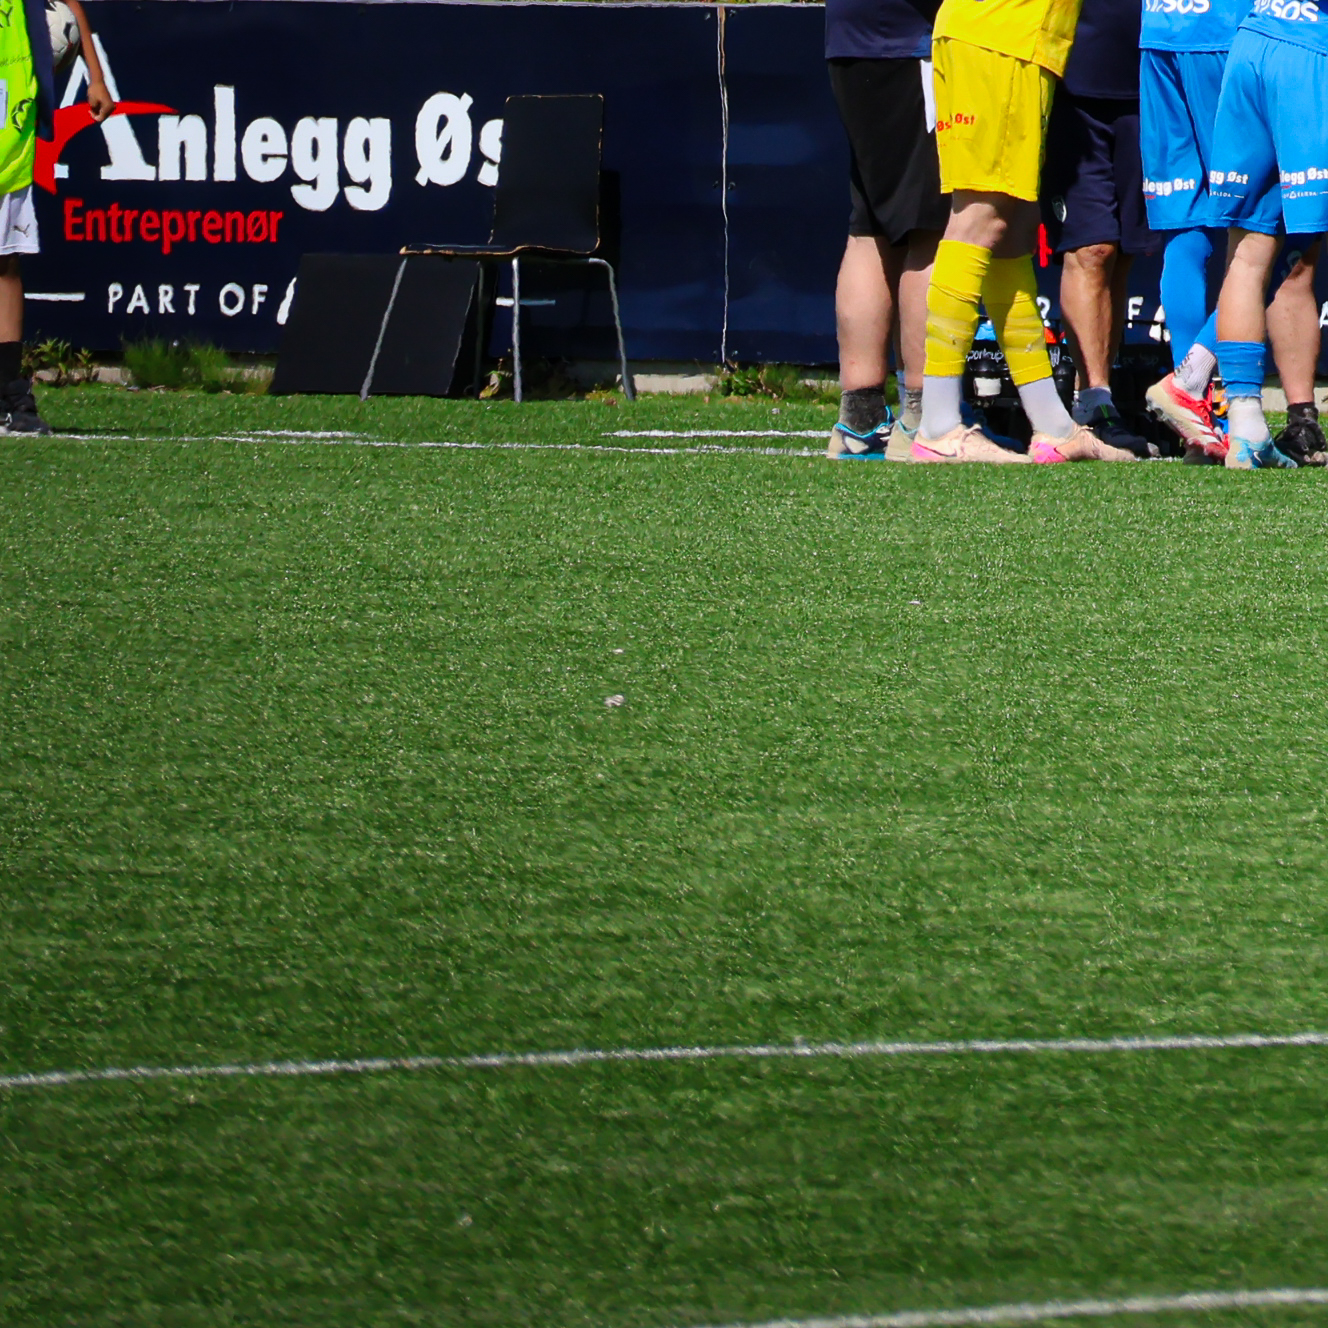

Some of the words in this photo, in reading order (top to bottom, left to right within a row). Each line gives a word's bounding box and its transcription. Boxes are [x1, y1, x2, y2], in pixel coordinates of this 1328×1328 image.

[53, 33, 391, 211] Anlegg
[1173, 178, 1196, 191] Øst
[1227, 171, 1249, 185] Øst
[64, 198, 283, 254] Entreprenør
[108, 282, 198, 314] PART
[219, 283, 268, 317] OF
